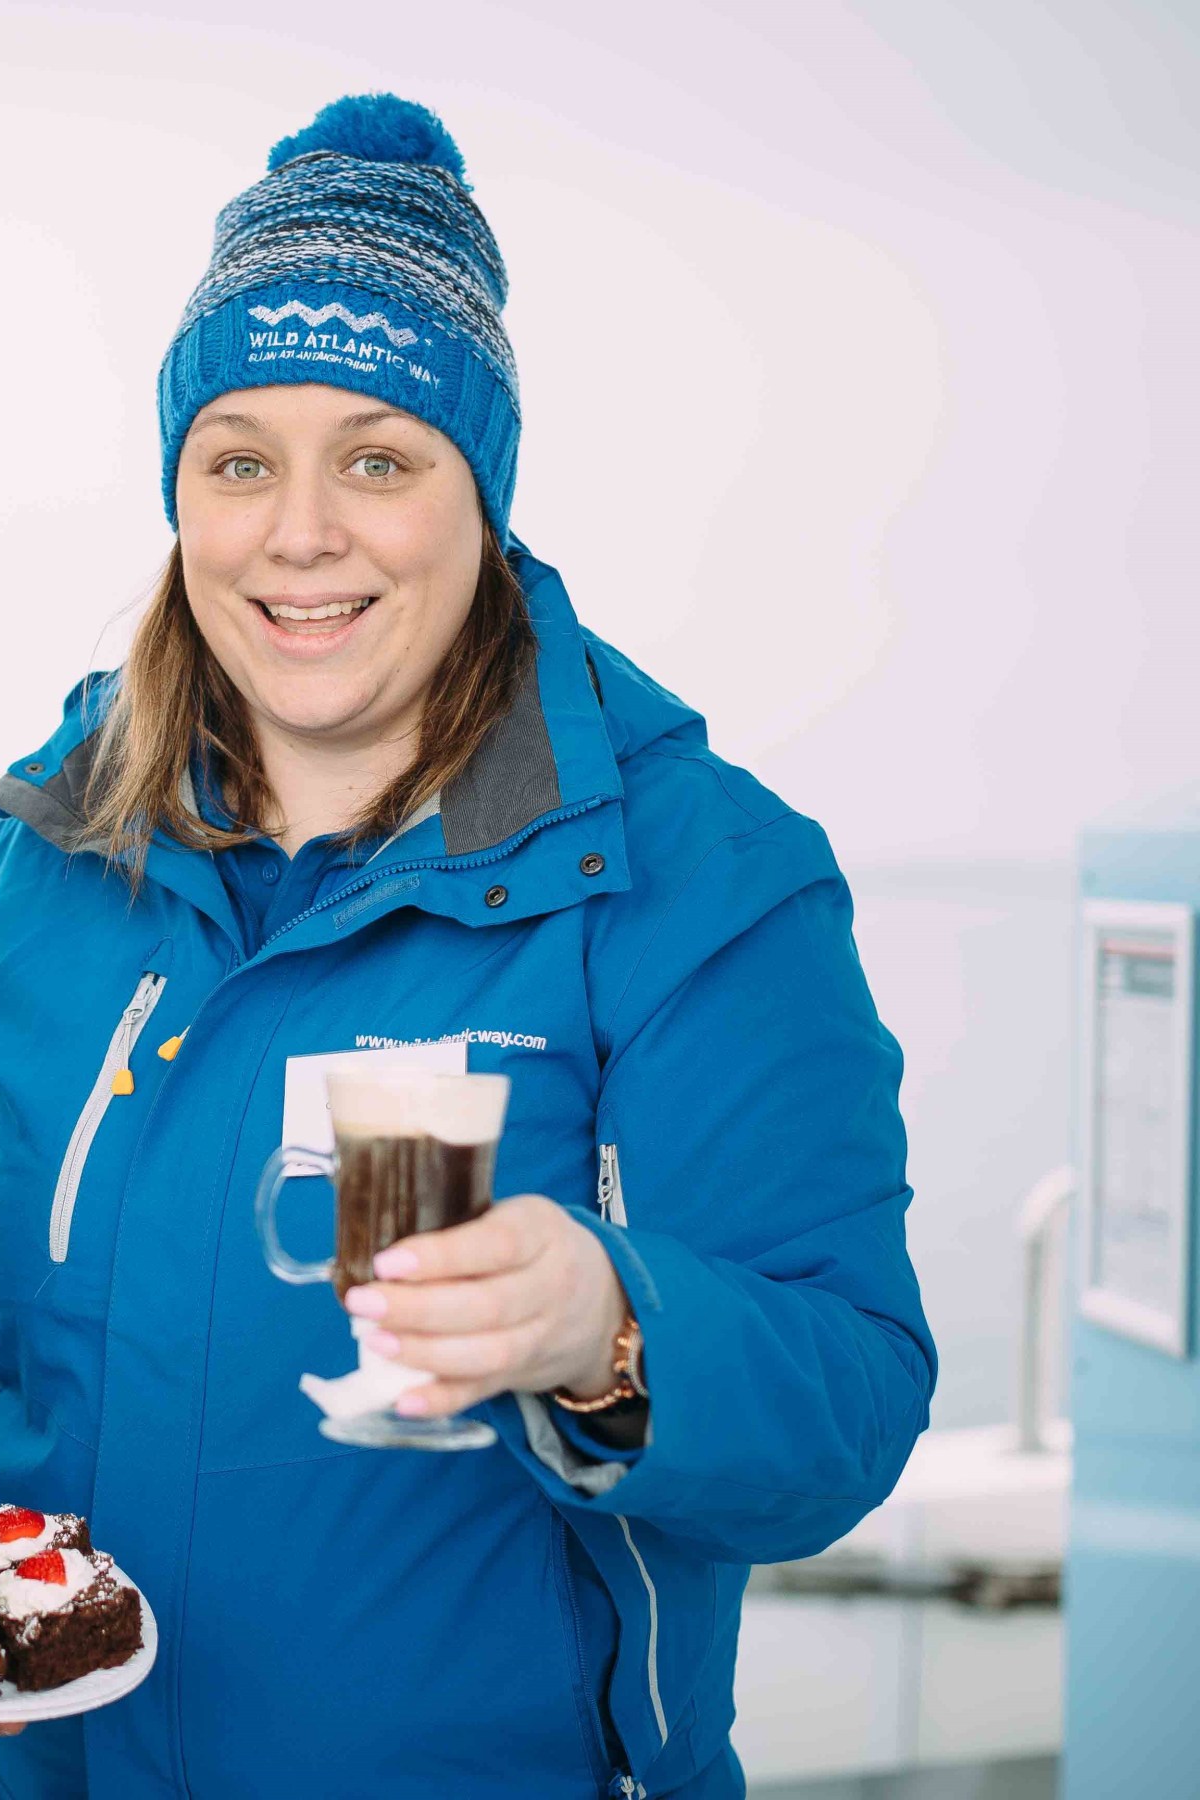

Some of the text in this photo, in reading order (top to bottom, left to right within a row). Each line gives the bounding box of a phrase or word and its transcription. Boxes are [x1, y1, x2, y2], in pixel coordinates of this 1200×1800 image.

[249, 331, 441, 390] WILD ATLANTIC WAY
